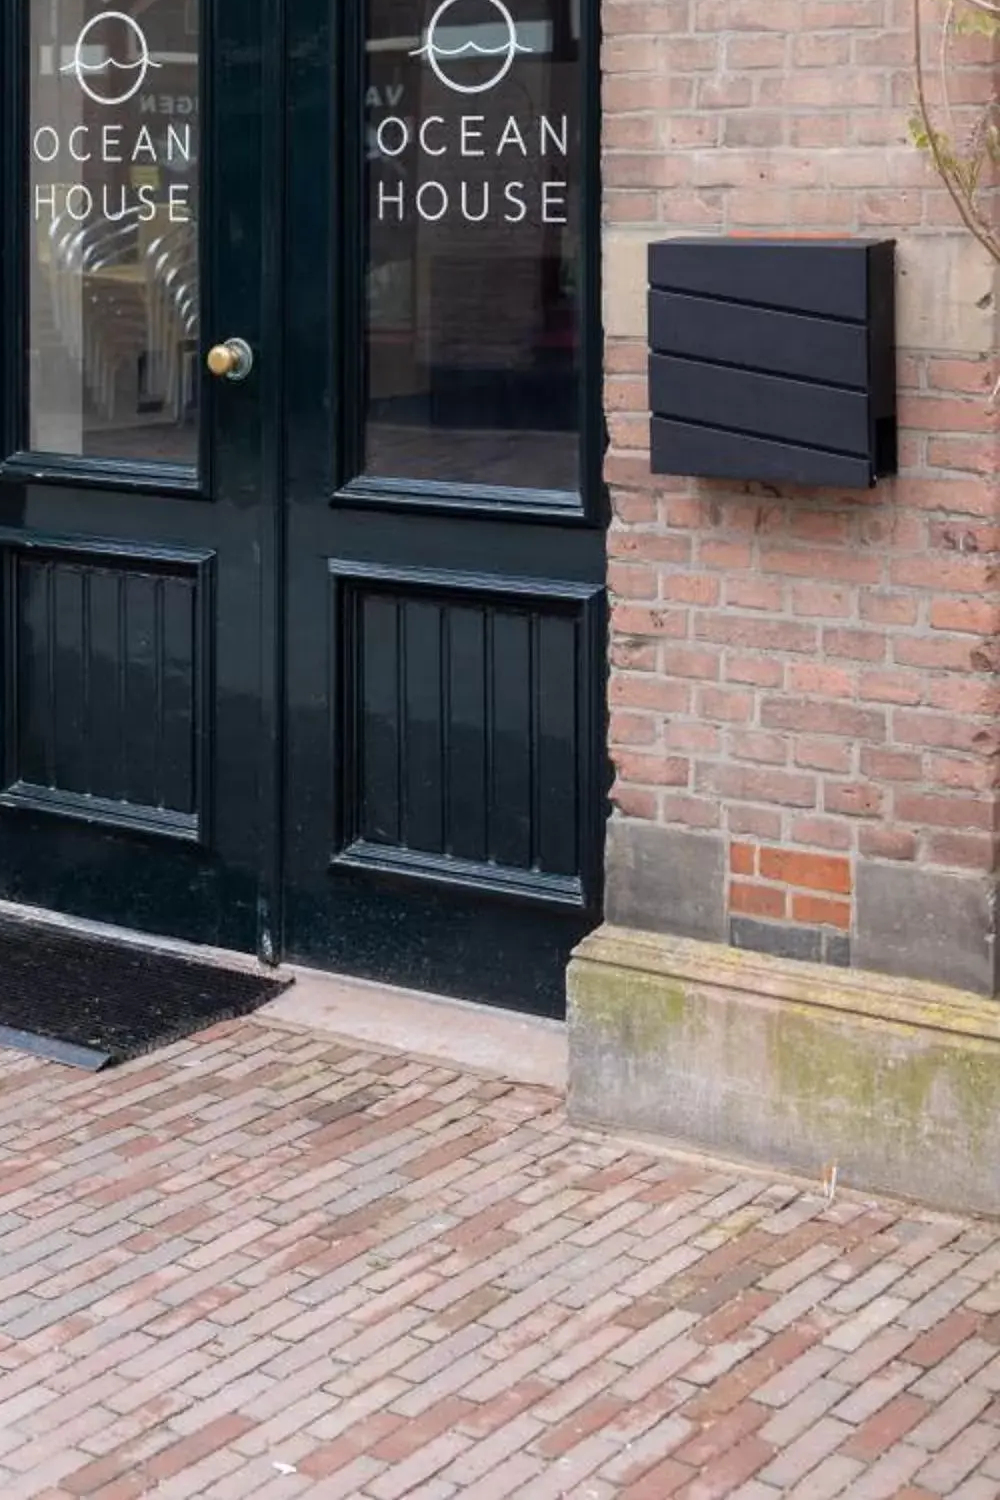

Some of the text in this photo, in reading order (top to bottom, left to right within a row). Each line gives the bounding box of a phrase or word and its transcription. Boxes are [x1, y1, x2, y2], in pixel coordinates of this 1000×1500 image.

[32, 124, 191, 162] OCEAN
[376, 115, 568, 157] OCEAN
[33, 184, 190, 223] HOUSE
[376, 180, 568, 223] HOUSE
